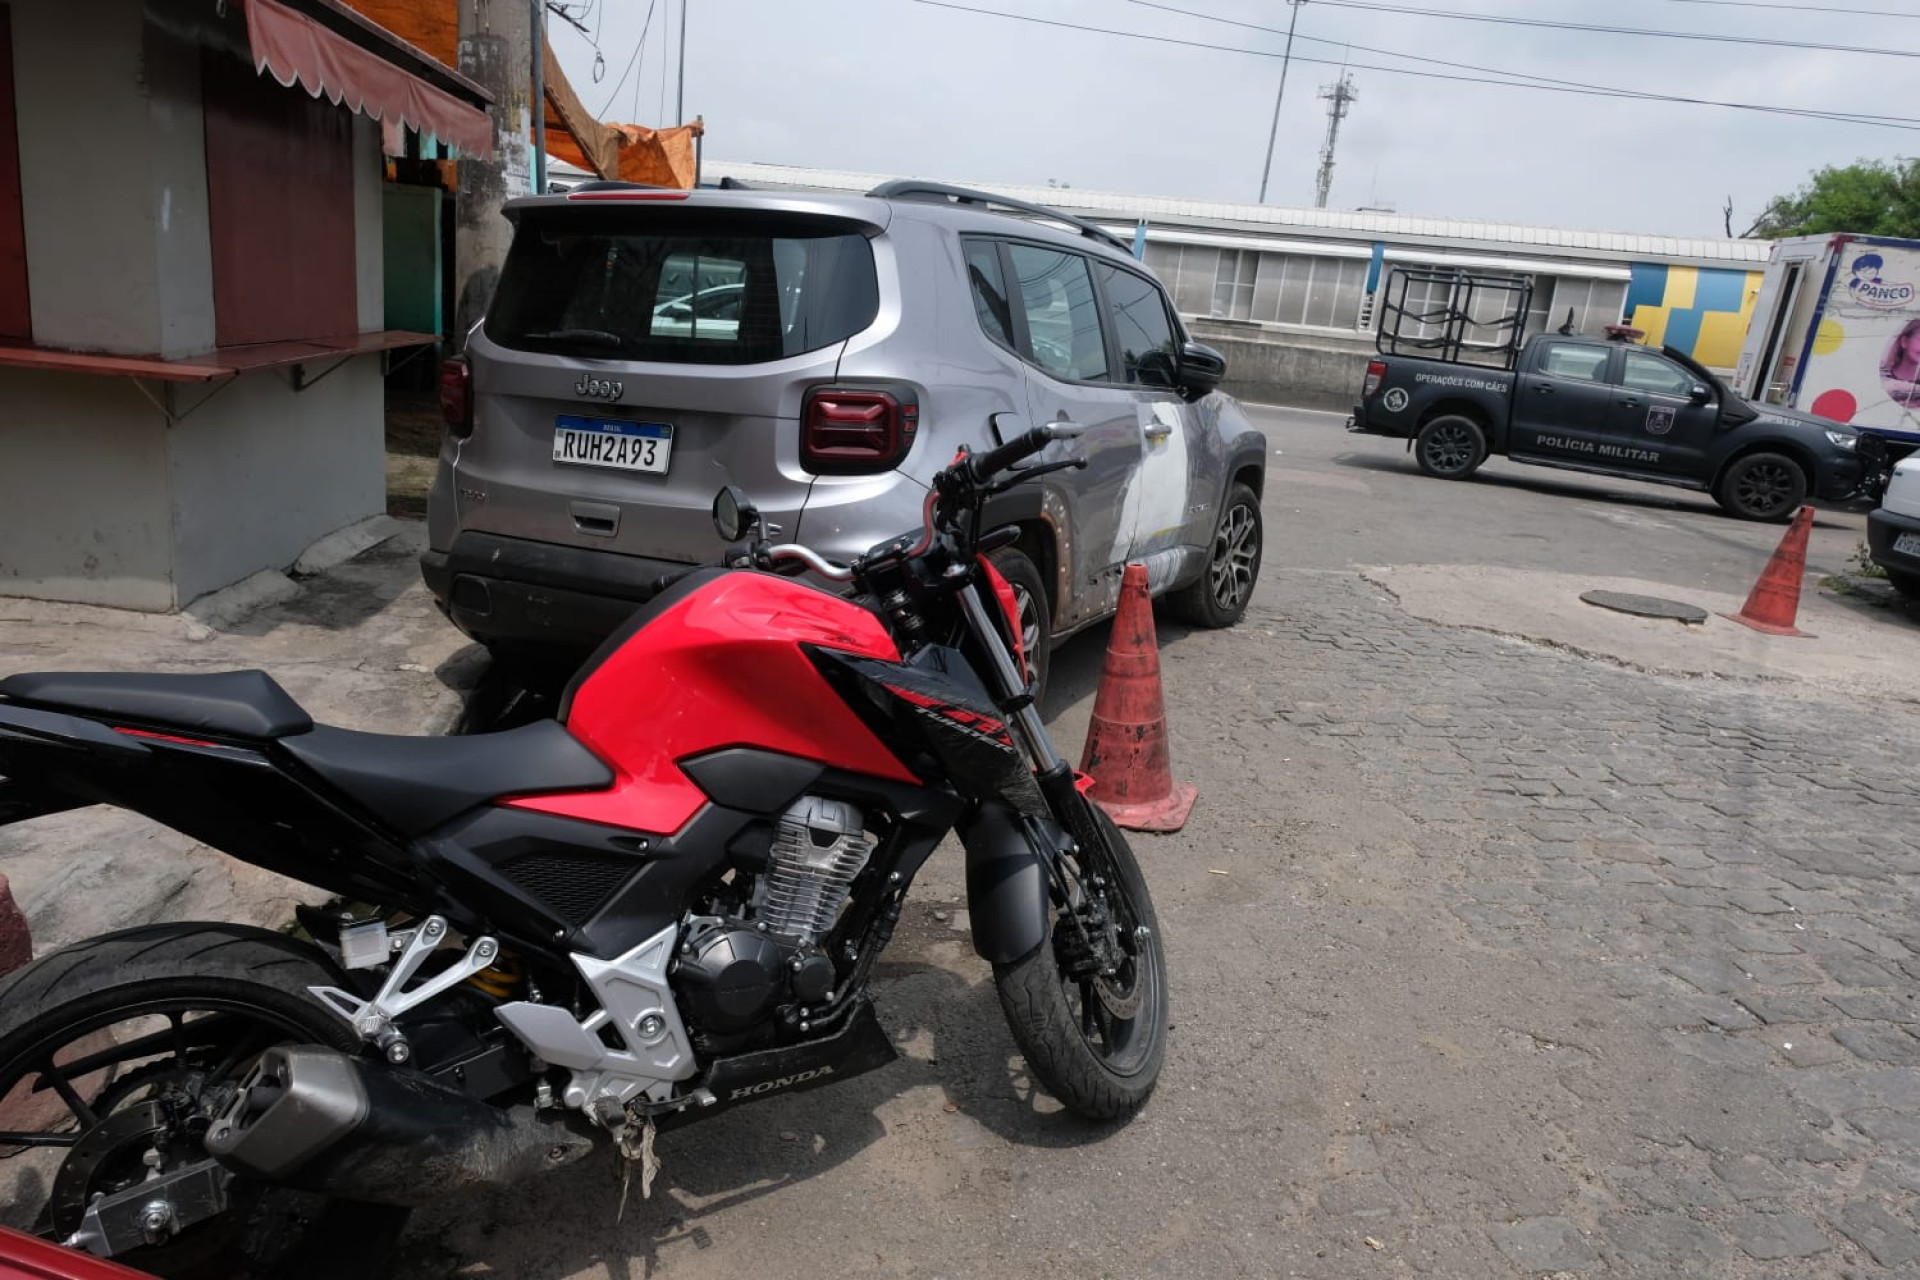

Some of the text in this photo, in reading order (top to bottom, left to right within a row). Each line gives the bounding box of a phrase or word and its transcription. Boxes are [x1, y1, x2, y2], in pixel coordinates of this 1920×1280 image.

[1859, 283, 1910, 299] PANCO
[575, 374, 624, 402] Jeep
[1465, 379, 1484, 390] COM
[563, 432, 658, 466] RUH2A93
[1536, 434, 1660, 463] POLÍCIA MILITAR
[730, 1064, 834, 1100] HONDA
